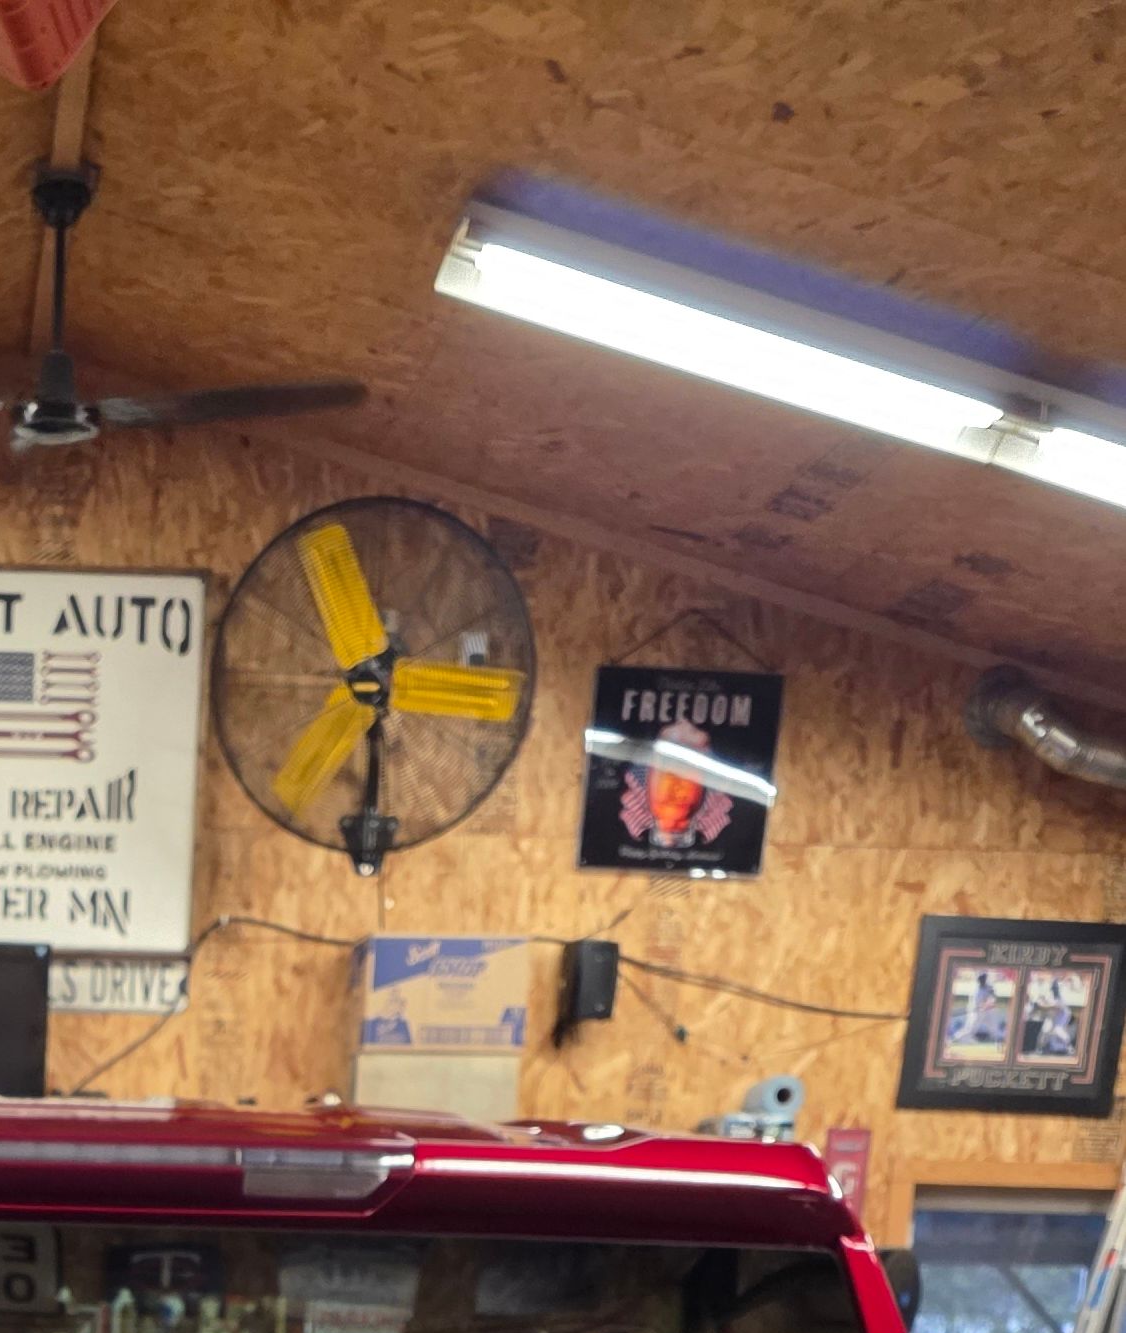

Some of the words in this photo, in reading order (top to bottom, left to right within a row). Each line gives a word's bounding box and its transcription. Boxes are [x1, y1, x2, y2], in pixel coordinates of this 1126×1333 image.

[53, 594, 192, 656] AUTO
[621, 689, 753, 727] FREEDOM
[11, 768, 137, 822] REPAIR
[25, 832, 118, 853] ENGINE
[14, 864, 106, 881] PLOWING
[70, 887, 131, 936] MN
[988, 942, 1068, 967] KIRBY
[89, 963, 177, 1007] DRIVE
[949, 1067, 1070, 1092] PUCKETT
